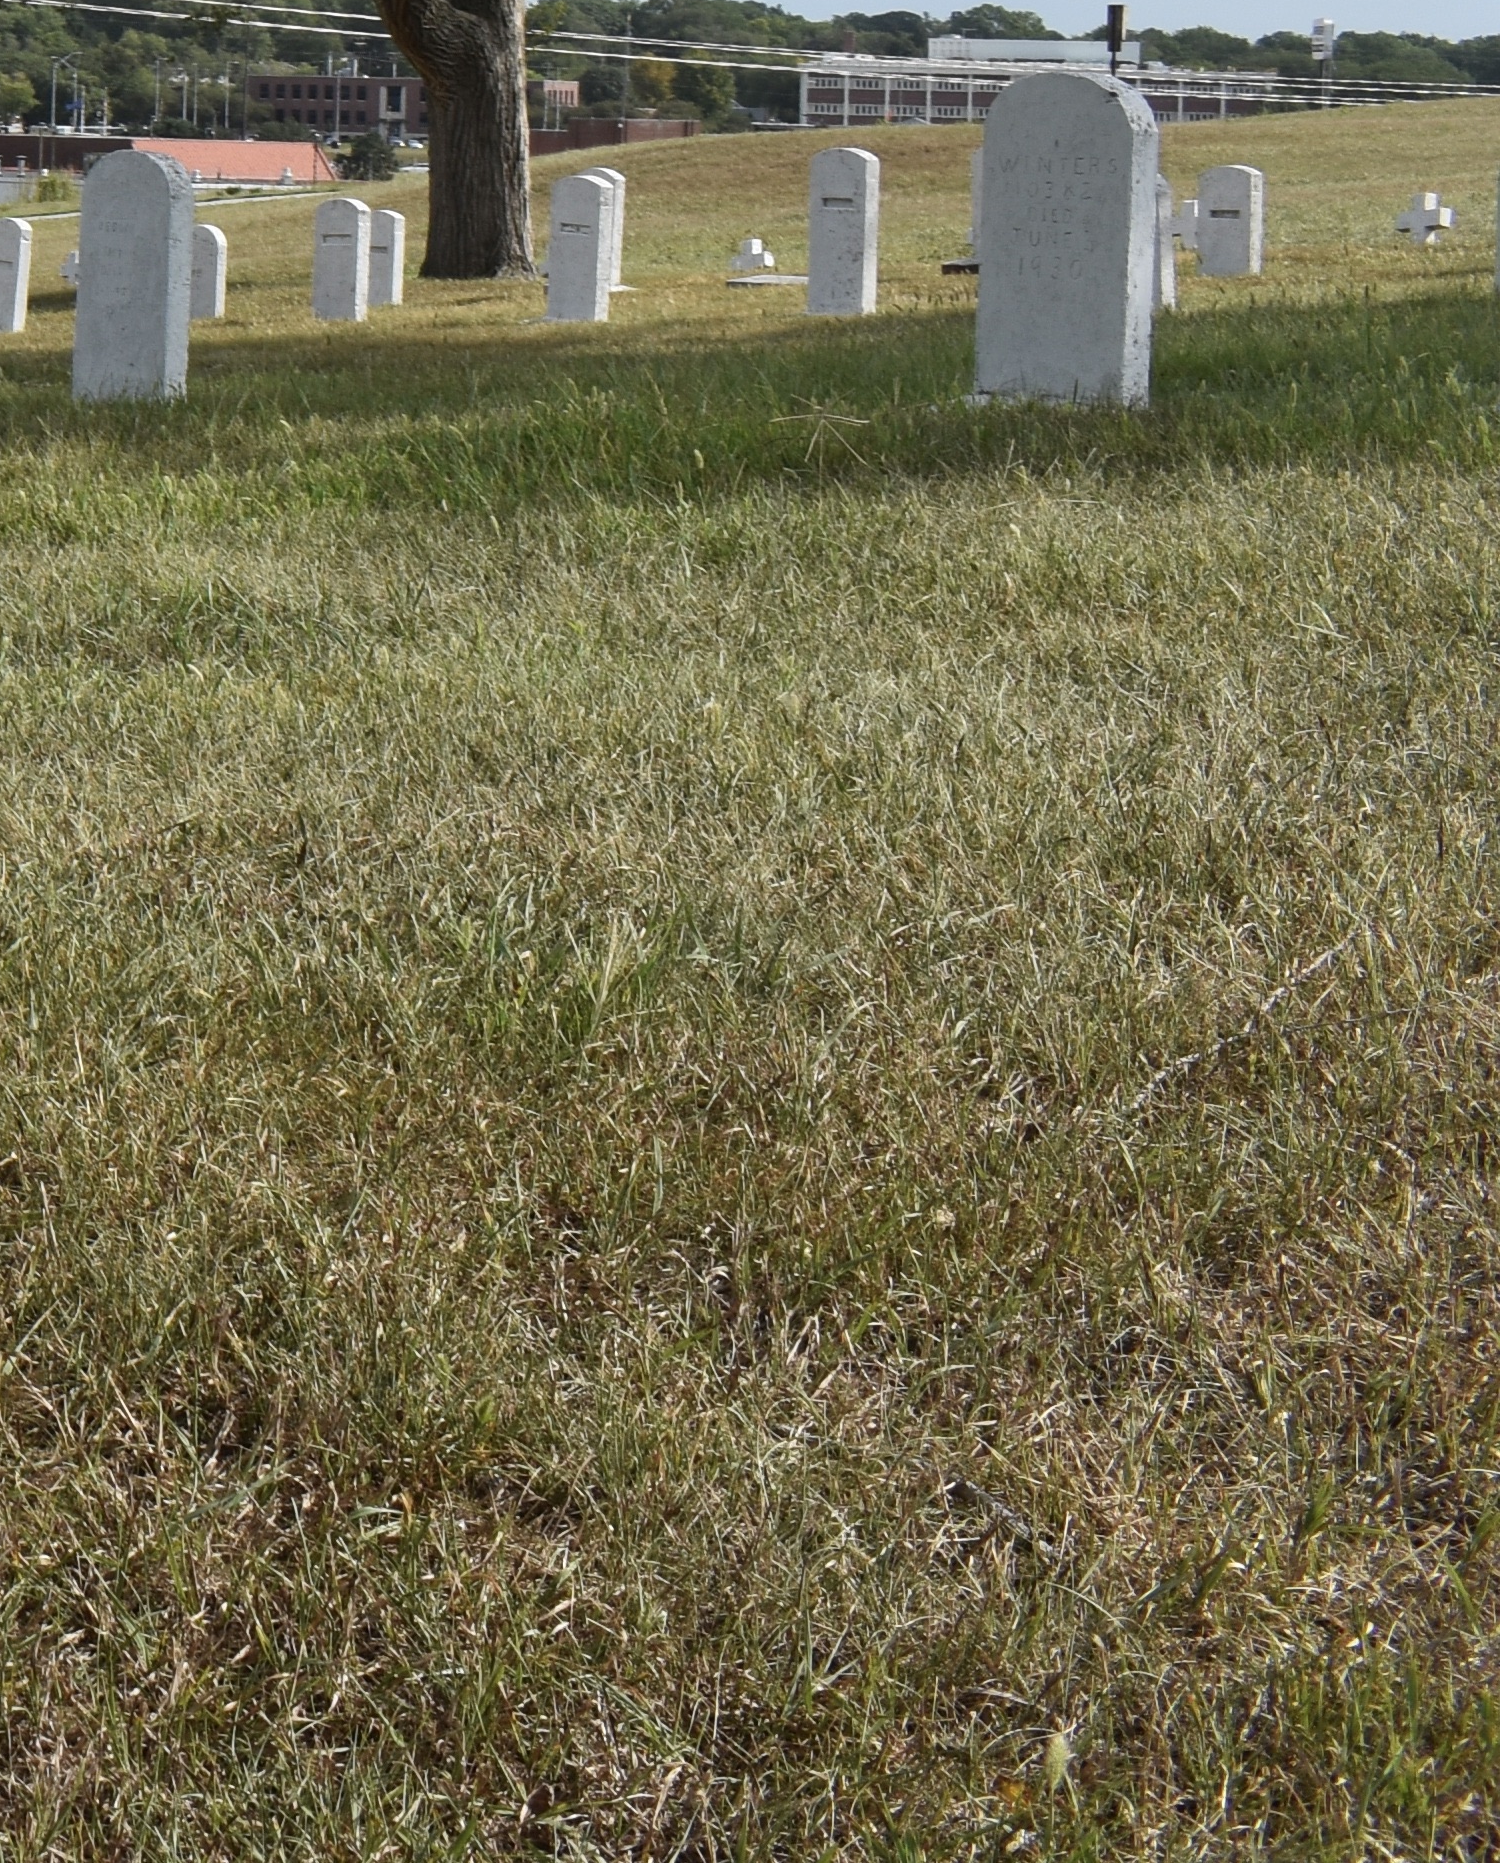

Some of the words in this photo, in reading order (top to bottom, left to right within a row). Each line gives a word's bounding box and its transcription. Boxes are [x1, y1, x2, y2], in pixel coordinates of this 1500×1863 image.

[997, 154, 1119, 176] WINTERS
[1027, 206, 1074, 225] DIED
[1017, 255, 1084, 281] 1930
